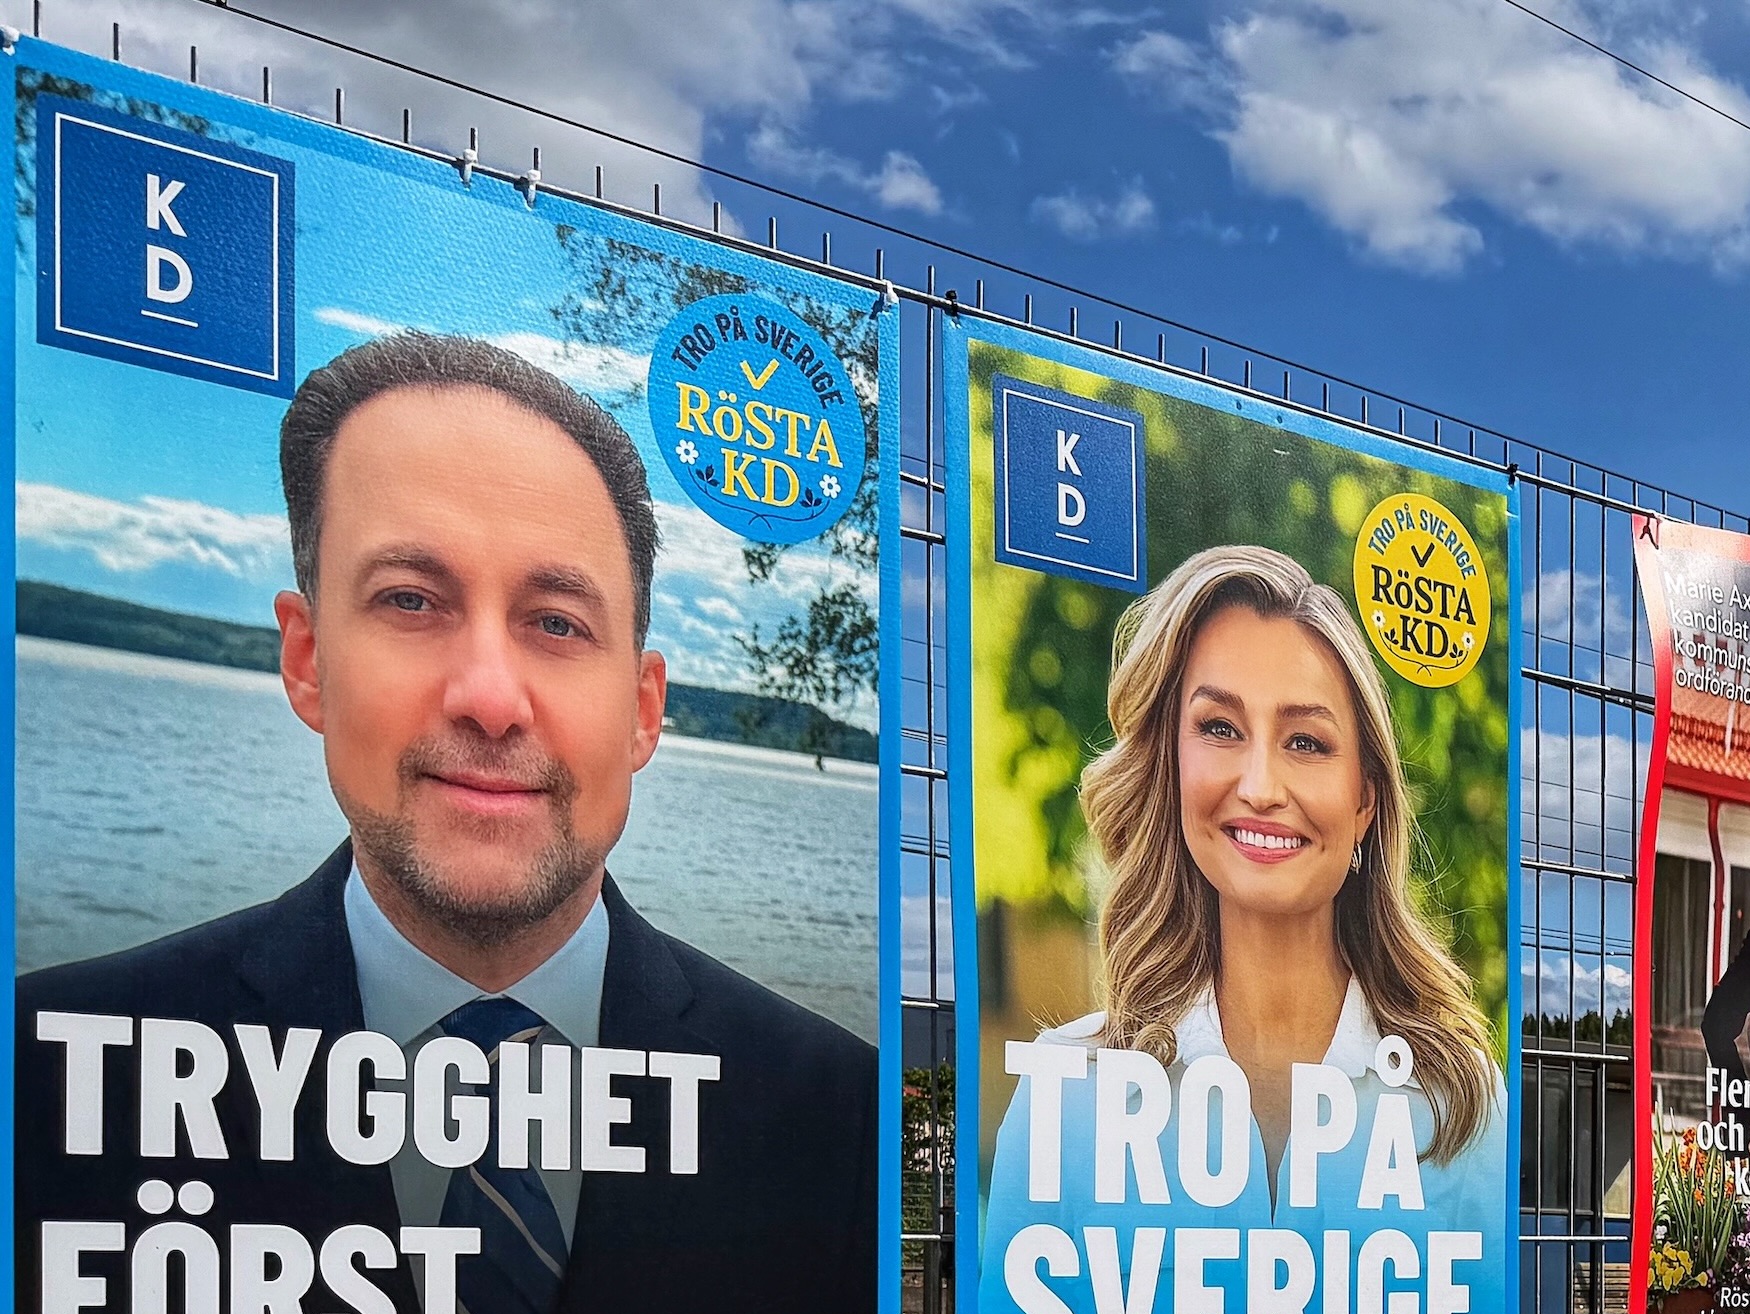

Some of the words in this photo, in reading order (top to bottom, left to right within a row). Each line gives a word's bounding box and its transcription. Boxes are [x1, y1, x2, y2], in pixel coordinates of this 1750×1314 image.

[146, 174, 186, 238] K
[146, 245, 193, 305] D
[672, 329, 716, 374] TRO
[716, 305, 750, 345] PÅ
[753, 314, 845, 411] SVERIGE
[722, 450, 802, 509] KD
[1056, 431, 1082, 477] K
[1056, 485, 1086, 526] D
[1368, 520, 1394, 555] TRO
[1394, 502, 1416, 532] PÅ
[1419, 509, 1478, 579] SVERIGE
[1665, 574, 1724, 604] Marie
[1400, 615, 1449, 659] KD
[1670, 600, 1750, 640] kandidat
[35, 1010, 722, 1175] TRYGGHET
[1004, 1040, 1252, 1208] TRO
[1289, 1034, 1426, 1210] PÅ
[1697, 1114, 1744, 1151] och
